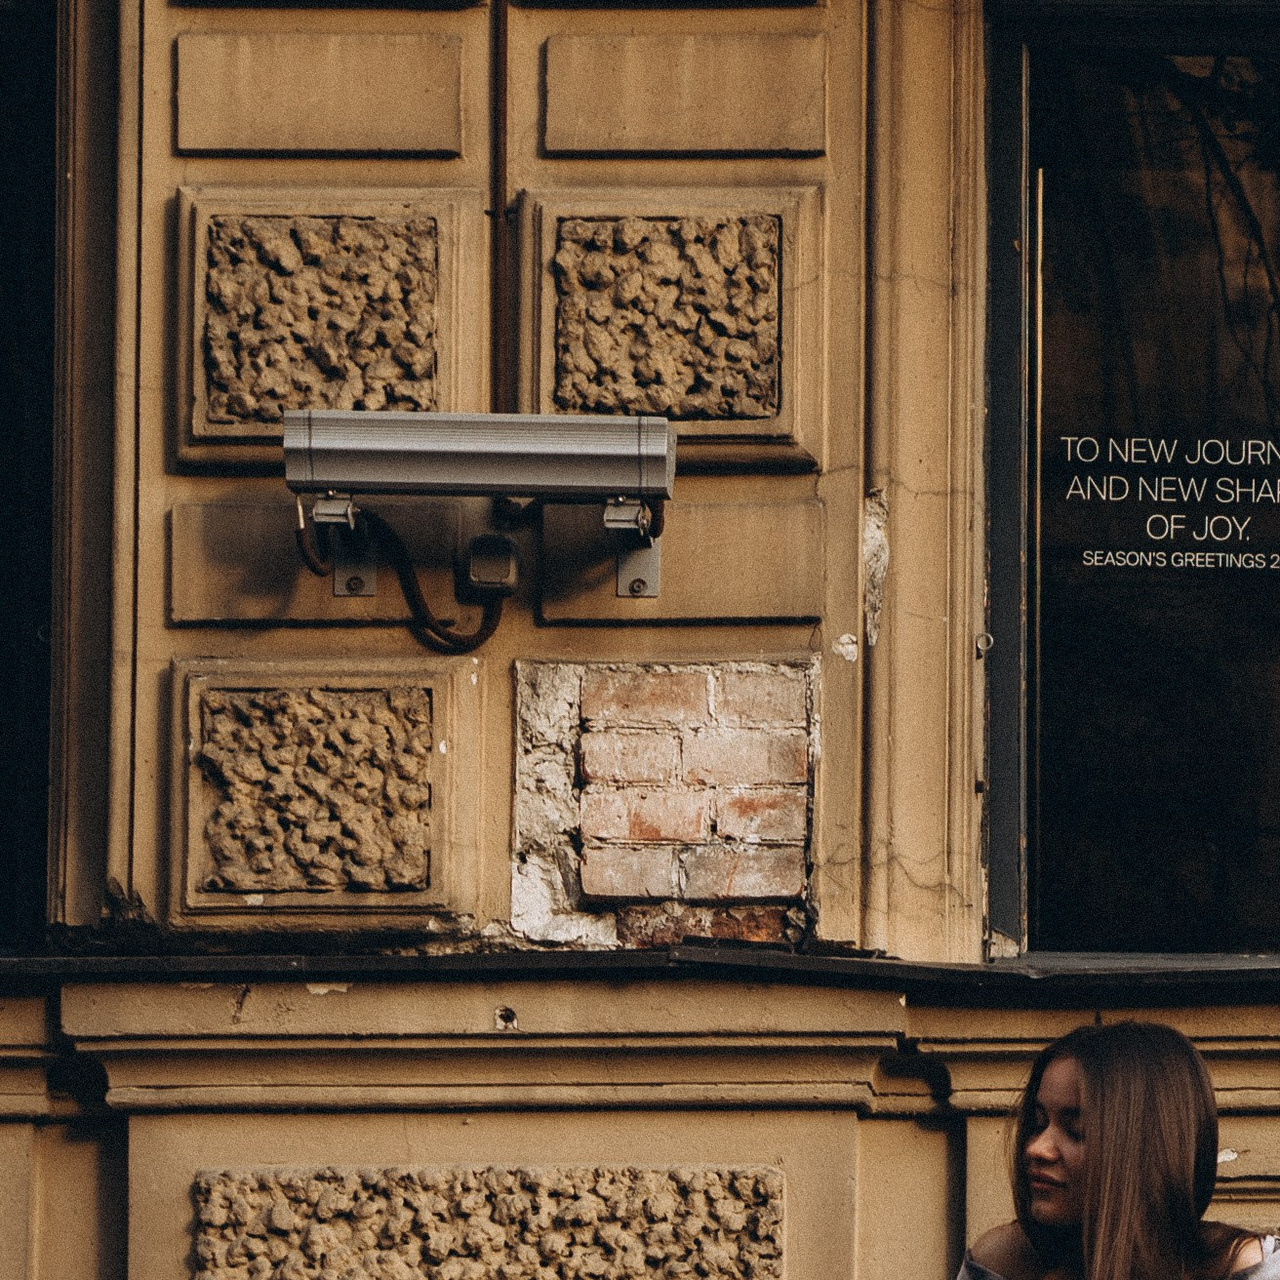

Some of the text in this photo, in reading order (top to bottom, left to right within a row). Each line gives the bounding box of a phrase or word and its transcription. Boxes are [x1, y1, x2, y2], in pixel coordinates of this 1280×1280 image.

[1060, 436, 1100, 462] TO
[1108, 438, 1178, 464] NEW
[1065, 475, 1129, 502] AND
[1137, 477, 1207, 503] NEW
[1145, 514, 1252, 542] OF JOY.
[1082, 550, 1167, 568] SEASON'S
[1170, 551, 1266, 569] GREETINGS
